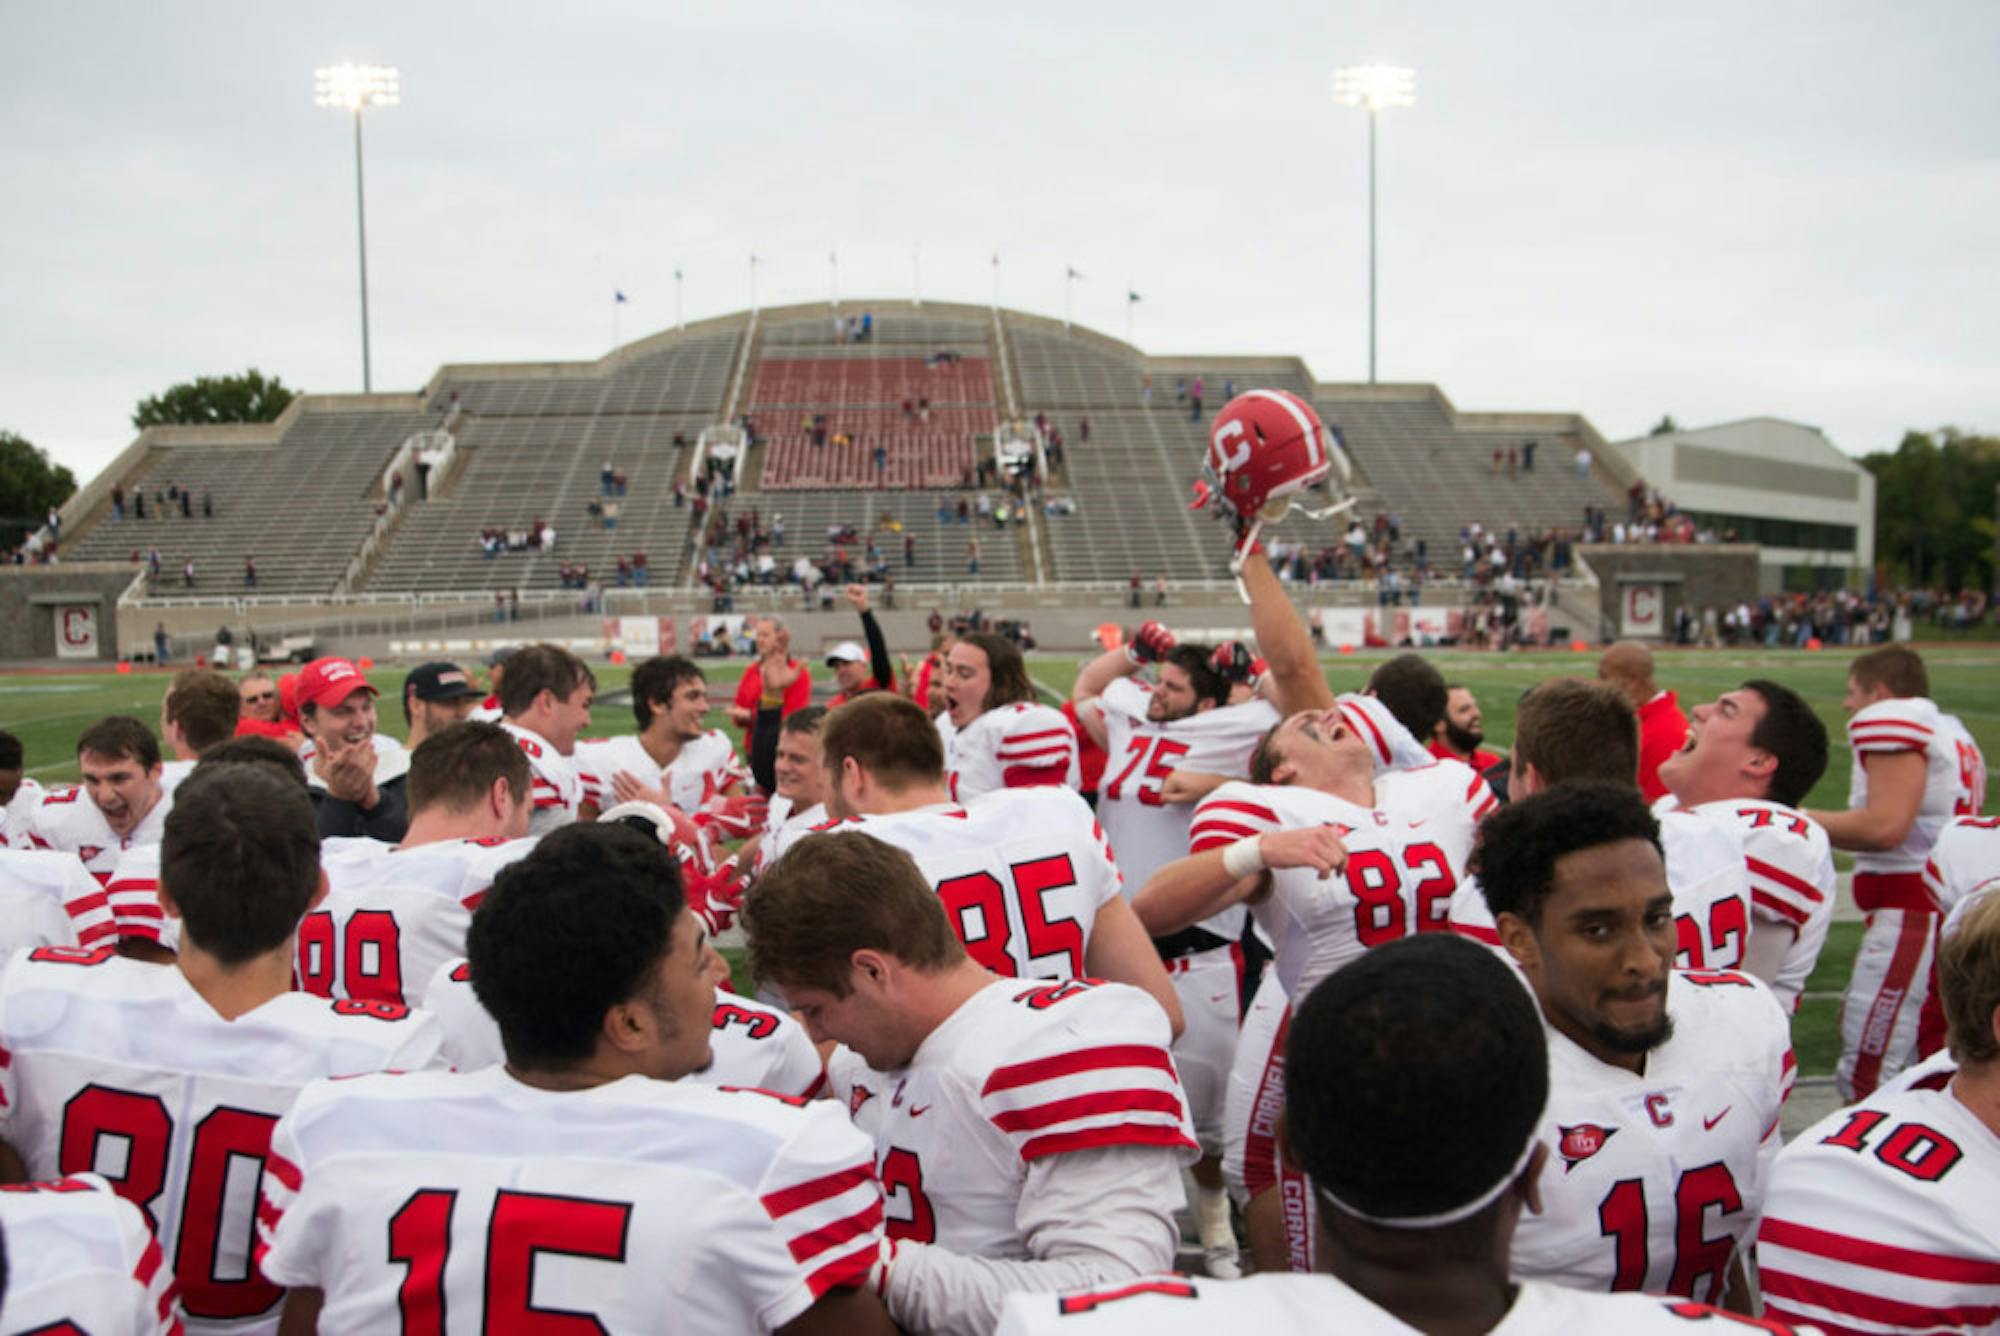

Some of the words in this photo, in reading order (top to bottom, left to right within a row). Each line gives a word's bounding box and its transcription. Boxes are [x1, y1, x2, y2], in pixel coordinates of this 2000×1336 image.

[1214, 419, 1252, 472] C
[63, 607, 90, 646] C
[1629, 586, 1655, 624] C
[1107, 735, 1191, 808] 75
[936, 852, 1077, 980] 85
[1344, 841, 1457, 948] 82
[1862, 988, 1906, 1056] CORNELL
[1643, 1093, 1675, 1128] C
[1818, 1109, 1965, 1183] 10
[59, 1082, 288, 1319] 80
[1598, 1159, 1743, 1304] 16
[387, 1188, 635, 1336] 15
